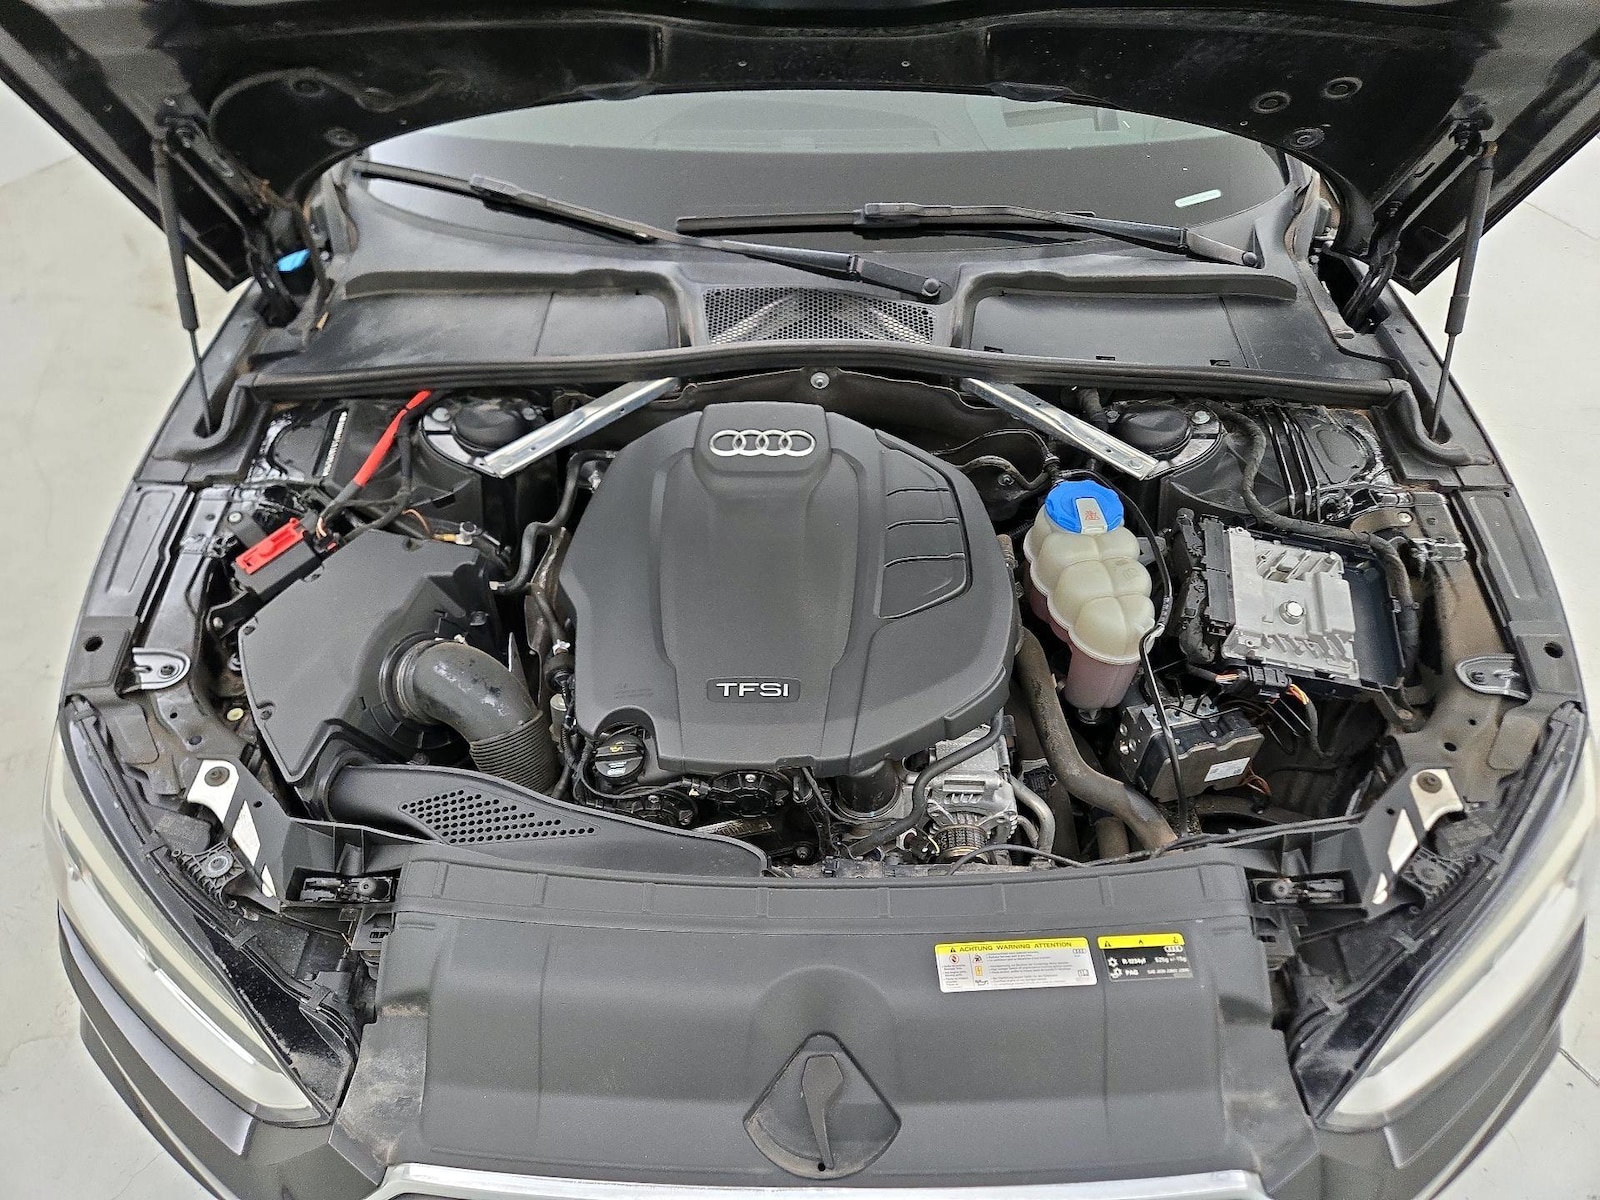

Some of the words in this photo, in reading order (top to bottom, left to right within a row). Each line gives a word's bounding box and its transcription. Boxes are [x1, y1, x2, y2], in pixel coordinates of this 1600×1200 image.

[716, 682, 789, 697] TFSI
[960, 945, 993, 953] ACHTUNG
[996, 943, 1031, 951] WARNING
